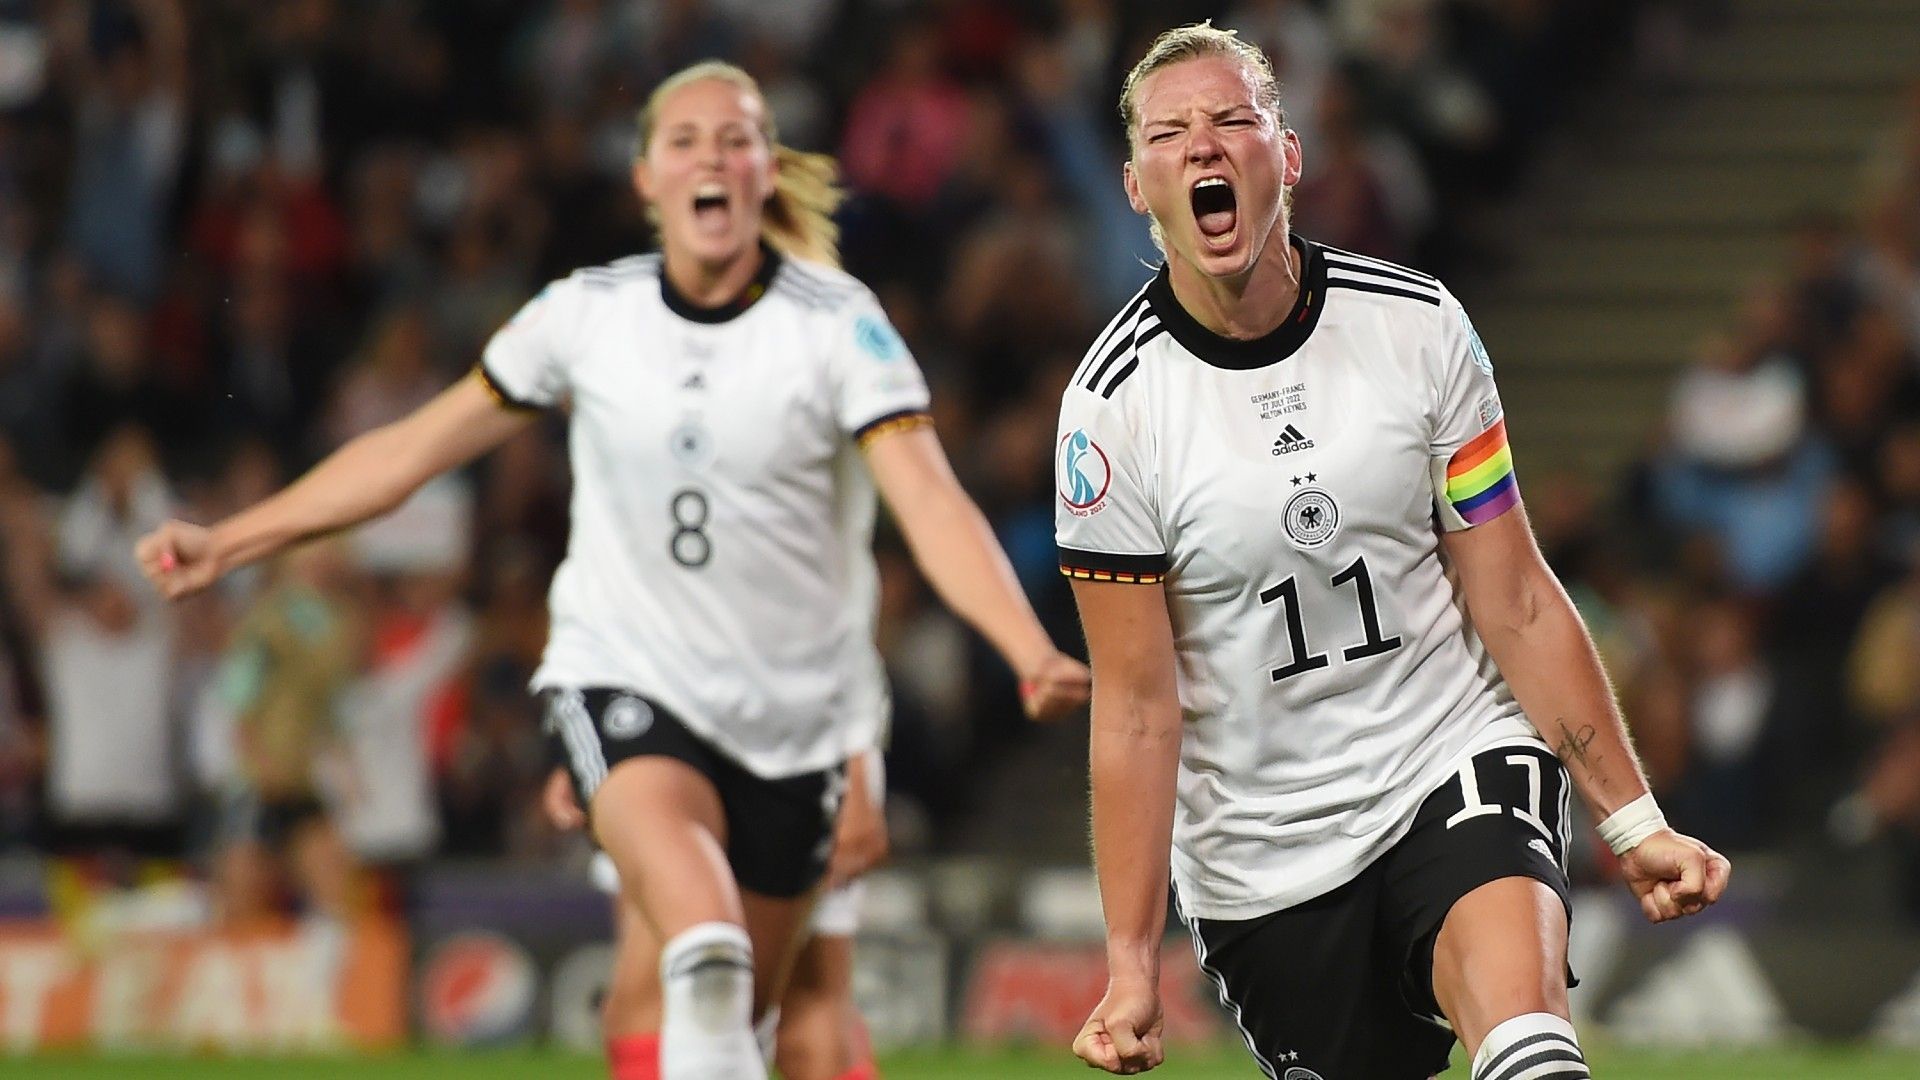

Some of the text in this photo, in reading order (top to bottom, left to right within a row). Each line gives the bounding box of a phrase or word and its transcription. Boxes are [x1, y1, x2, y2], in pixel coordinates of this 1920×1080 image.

[1250, 382, 1306, 403] GERMANY-FRANCE
[1261, 393, 1301, 411] 27 JULY 2022
[1260, 401, 1307, 420] MILTON KEYNES
[1271, 439, 1315, 456] adidas
[1089, 501, 1106, 515] 2022
[670, 489, 711, 568] 8
[1259, 555, 1402, 682] 11
[1446, 754, 1554, 843] 11
